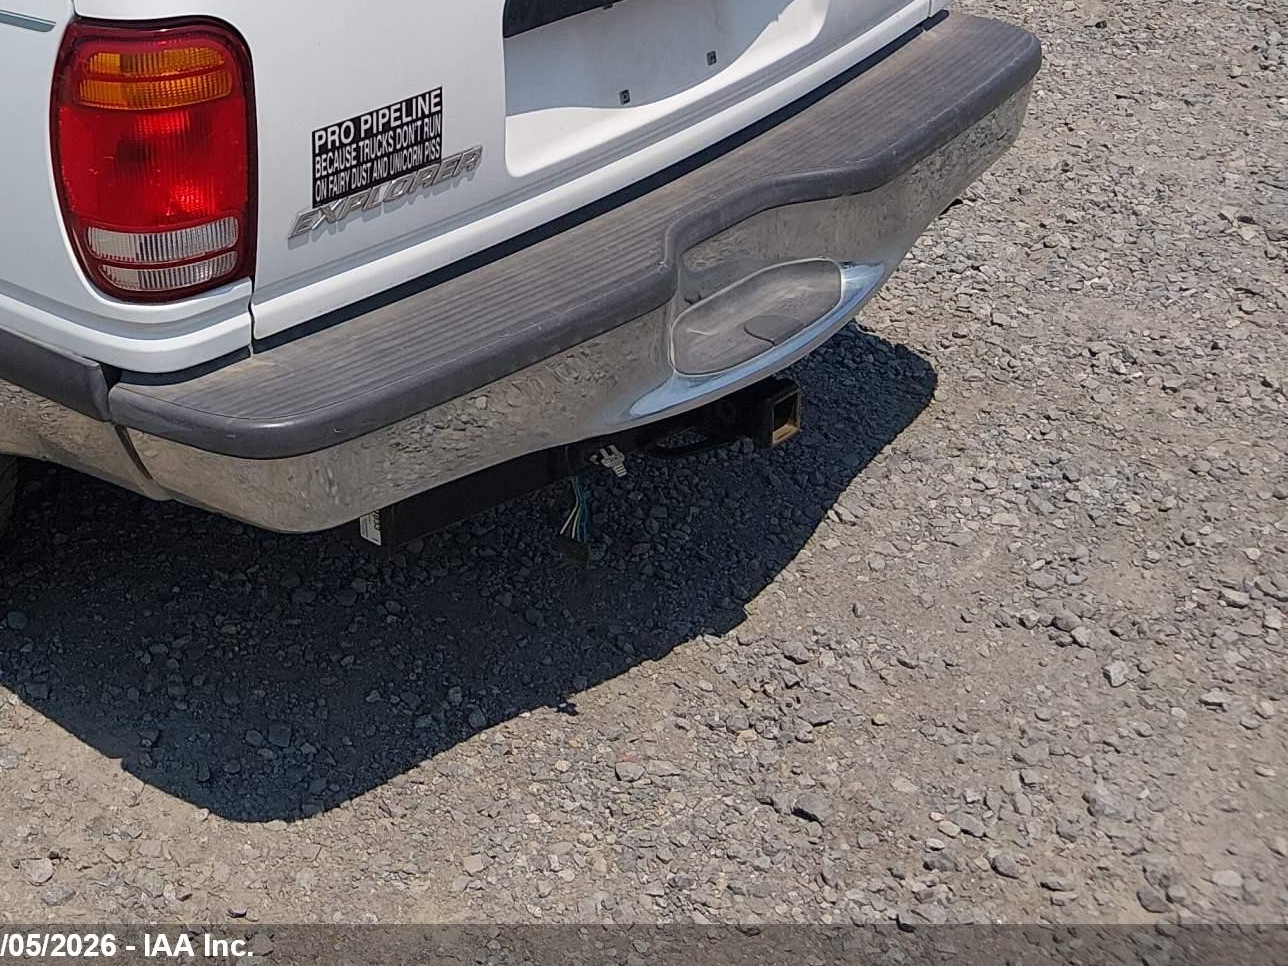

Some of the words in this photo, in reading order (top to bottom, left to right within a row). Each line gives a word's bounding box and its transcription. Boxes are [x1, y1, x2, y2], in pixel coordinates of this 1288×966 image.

[314, 121, 355, 154] PRO
[360, 88, 442, 139] PIPELINE
[314, 143, 358, 179] BECAUSE
[358, 129, 395, 163] TRUCKS
[395, 121, 423, 151] DON'T
[422, 112, 442, 140] RUN
[287, 144, 483, 239] EXPLORER
[314, 179, 328, 202] ON
[328, 172, 351, 197] FAIRY
[350, 162, 372, 191] DUST
[372, 155, 390, 181] AND
[389, 143, 423, 176] UNICORN
[423, 136, 441, 162] PISS
